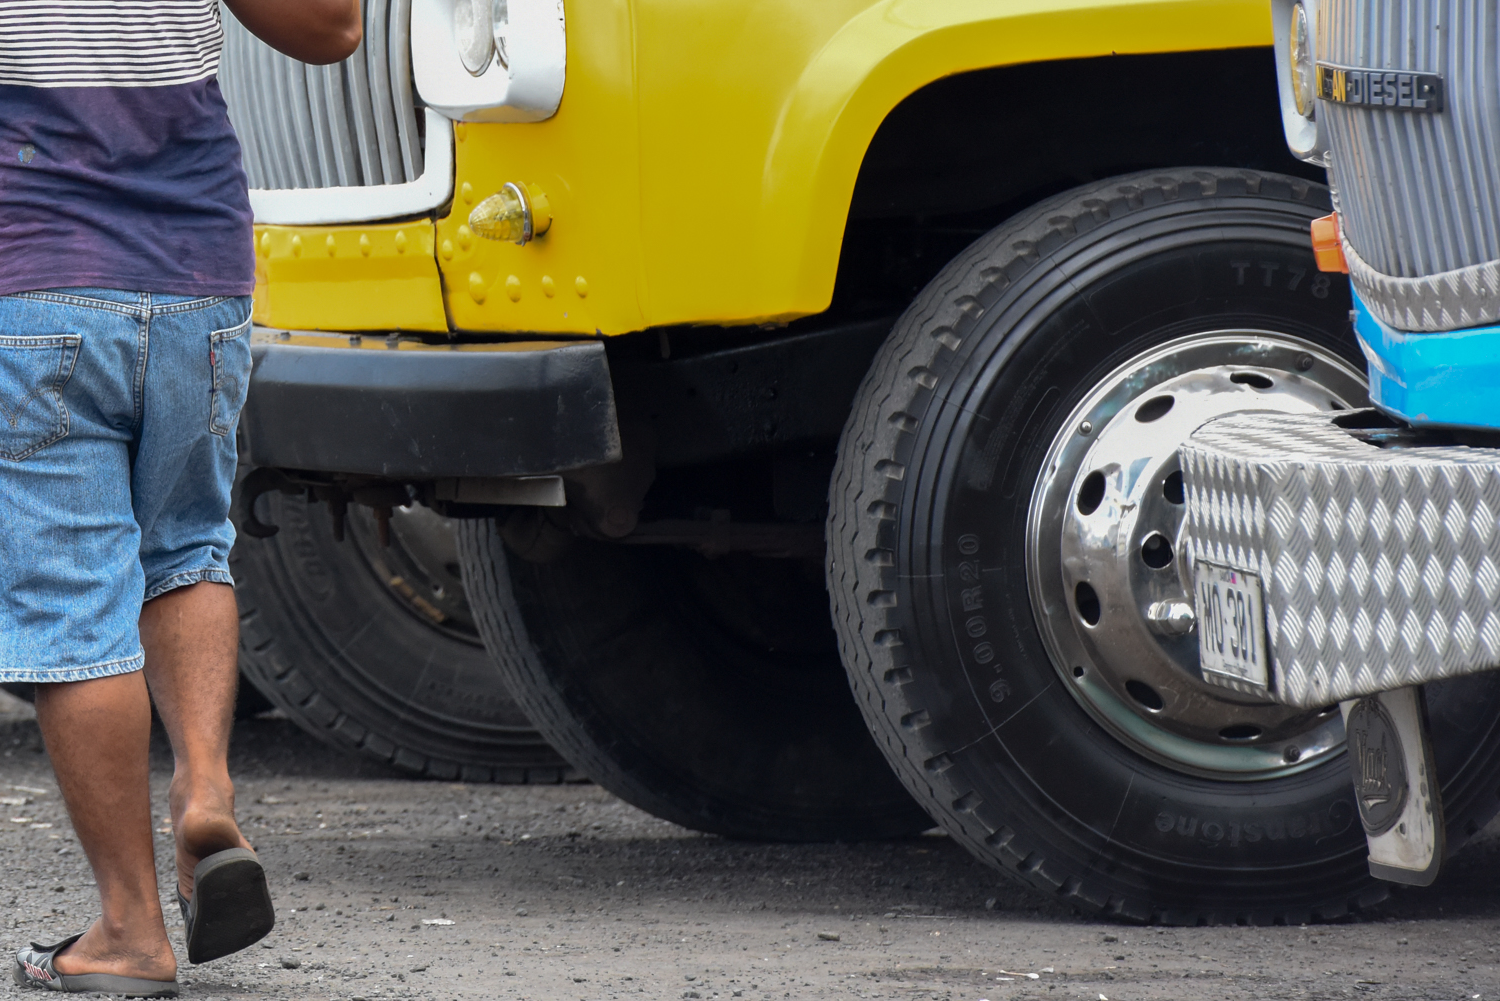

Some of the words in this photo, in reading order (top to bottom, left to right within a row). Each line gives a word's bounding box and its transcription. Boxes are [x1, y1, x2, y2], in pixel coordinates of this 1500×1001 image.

[1352, 71, 1427, 109] DIESEL
[1230, 260, 1331, 299] TT78
[957, 533, 1011, 703] 9.00R20
